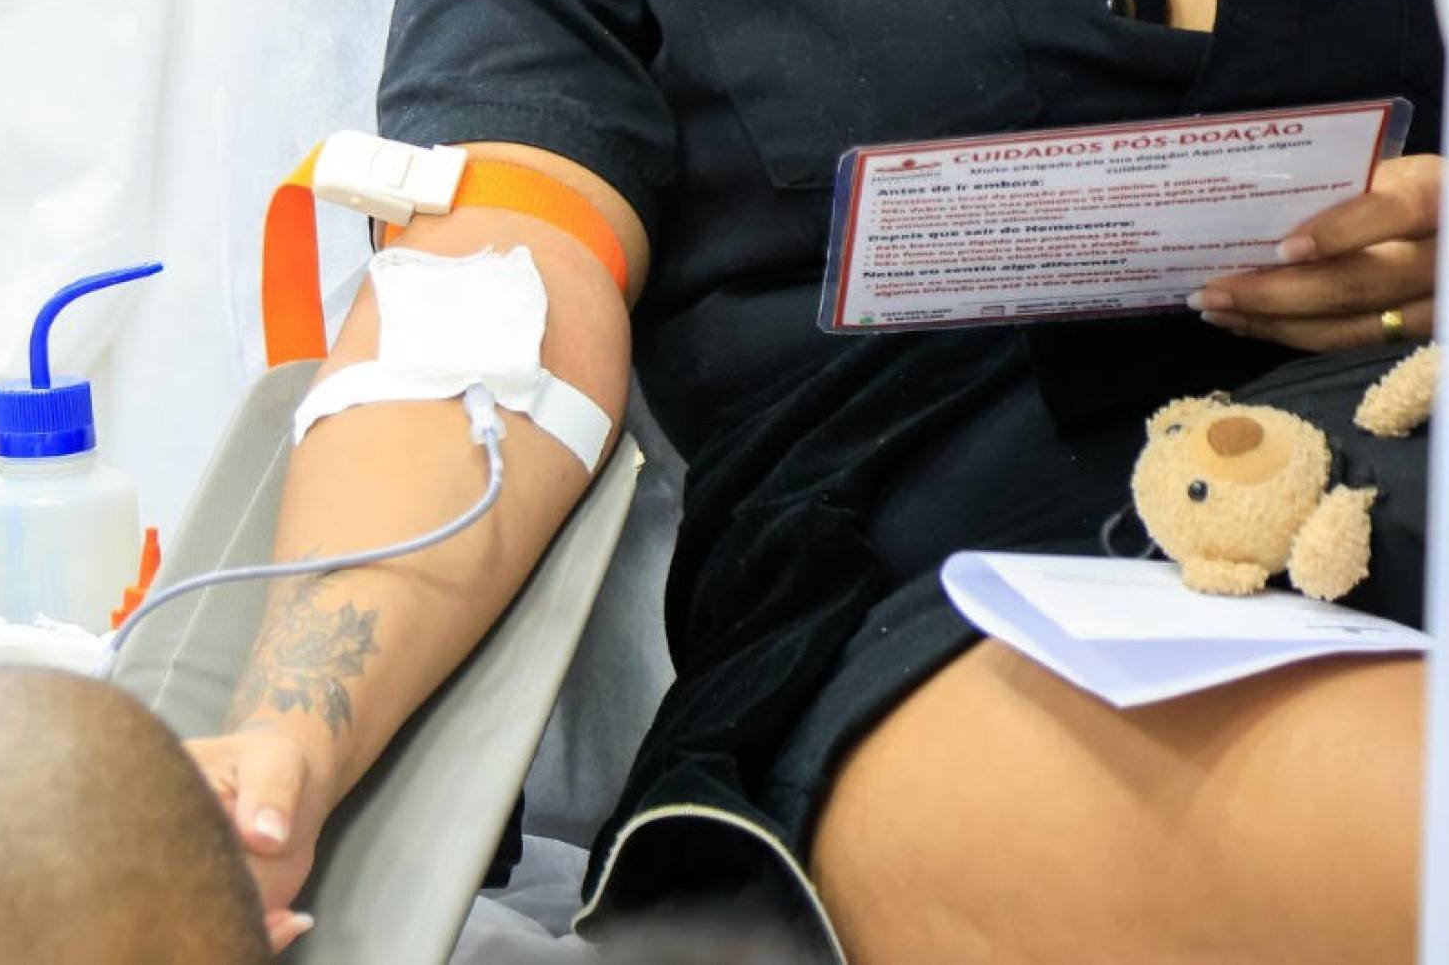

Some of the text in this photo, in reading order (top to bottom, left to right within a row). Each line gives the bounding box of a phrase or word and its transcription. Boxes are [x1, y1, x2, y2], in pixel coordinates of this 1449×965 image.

[953, 122, 1304, 164] CUIDADOS PÓS-DOAÇÃO
[970, 166, 1009, 175] Muito
[1013, 162, 1073, 172] obrigado
[1076, 159, 1105, 168] pela
[1192, 147, 1224, 159] Aqui
[1227, 143, 1264, 153] estão
[1267, 138, 1313, 151] alguns
[877, 179, 1044, 197] Antes de ir embora:
[868, 220, 1135, 243] Depois que sair do Hemocentro:
[863, 257, 1127, 278] Notou ou sentiu algo diferente?
